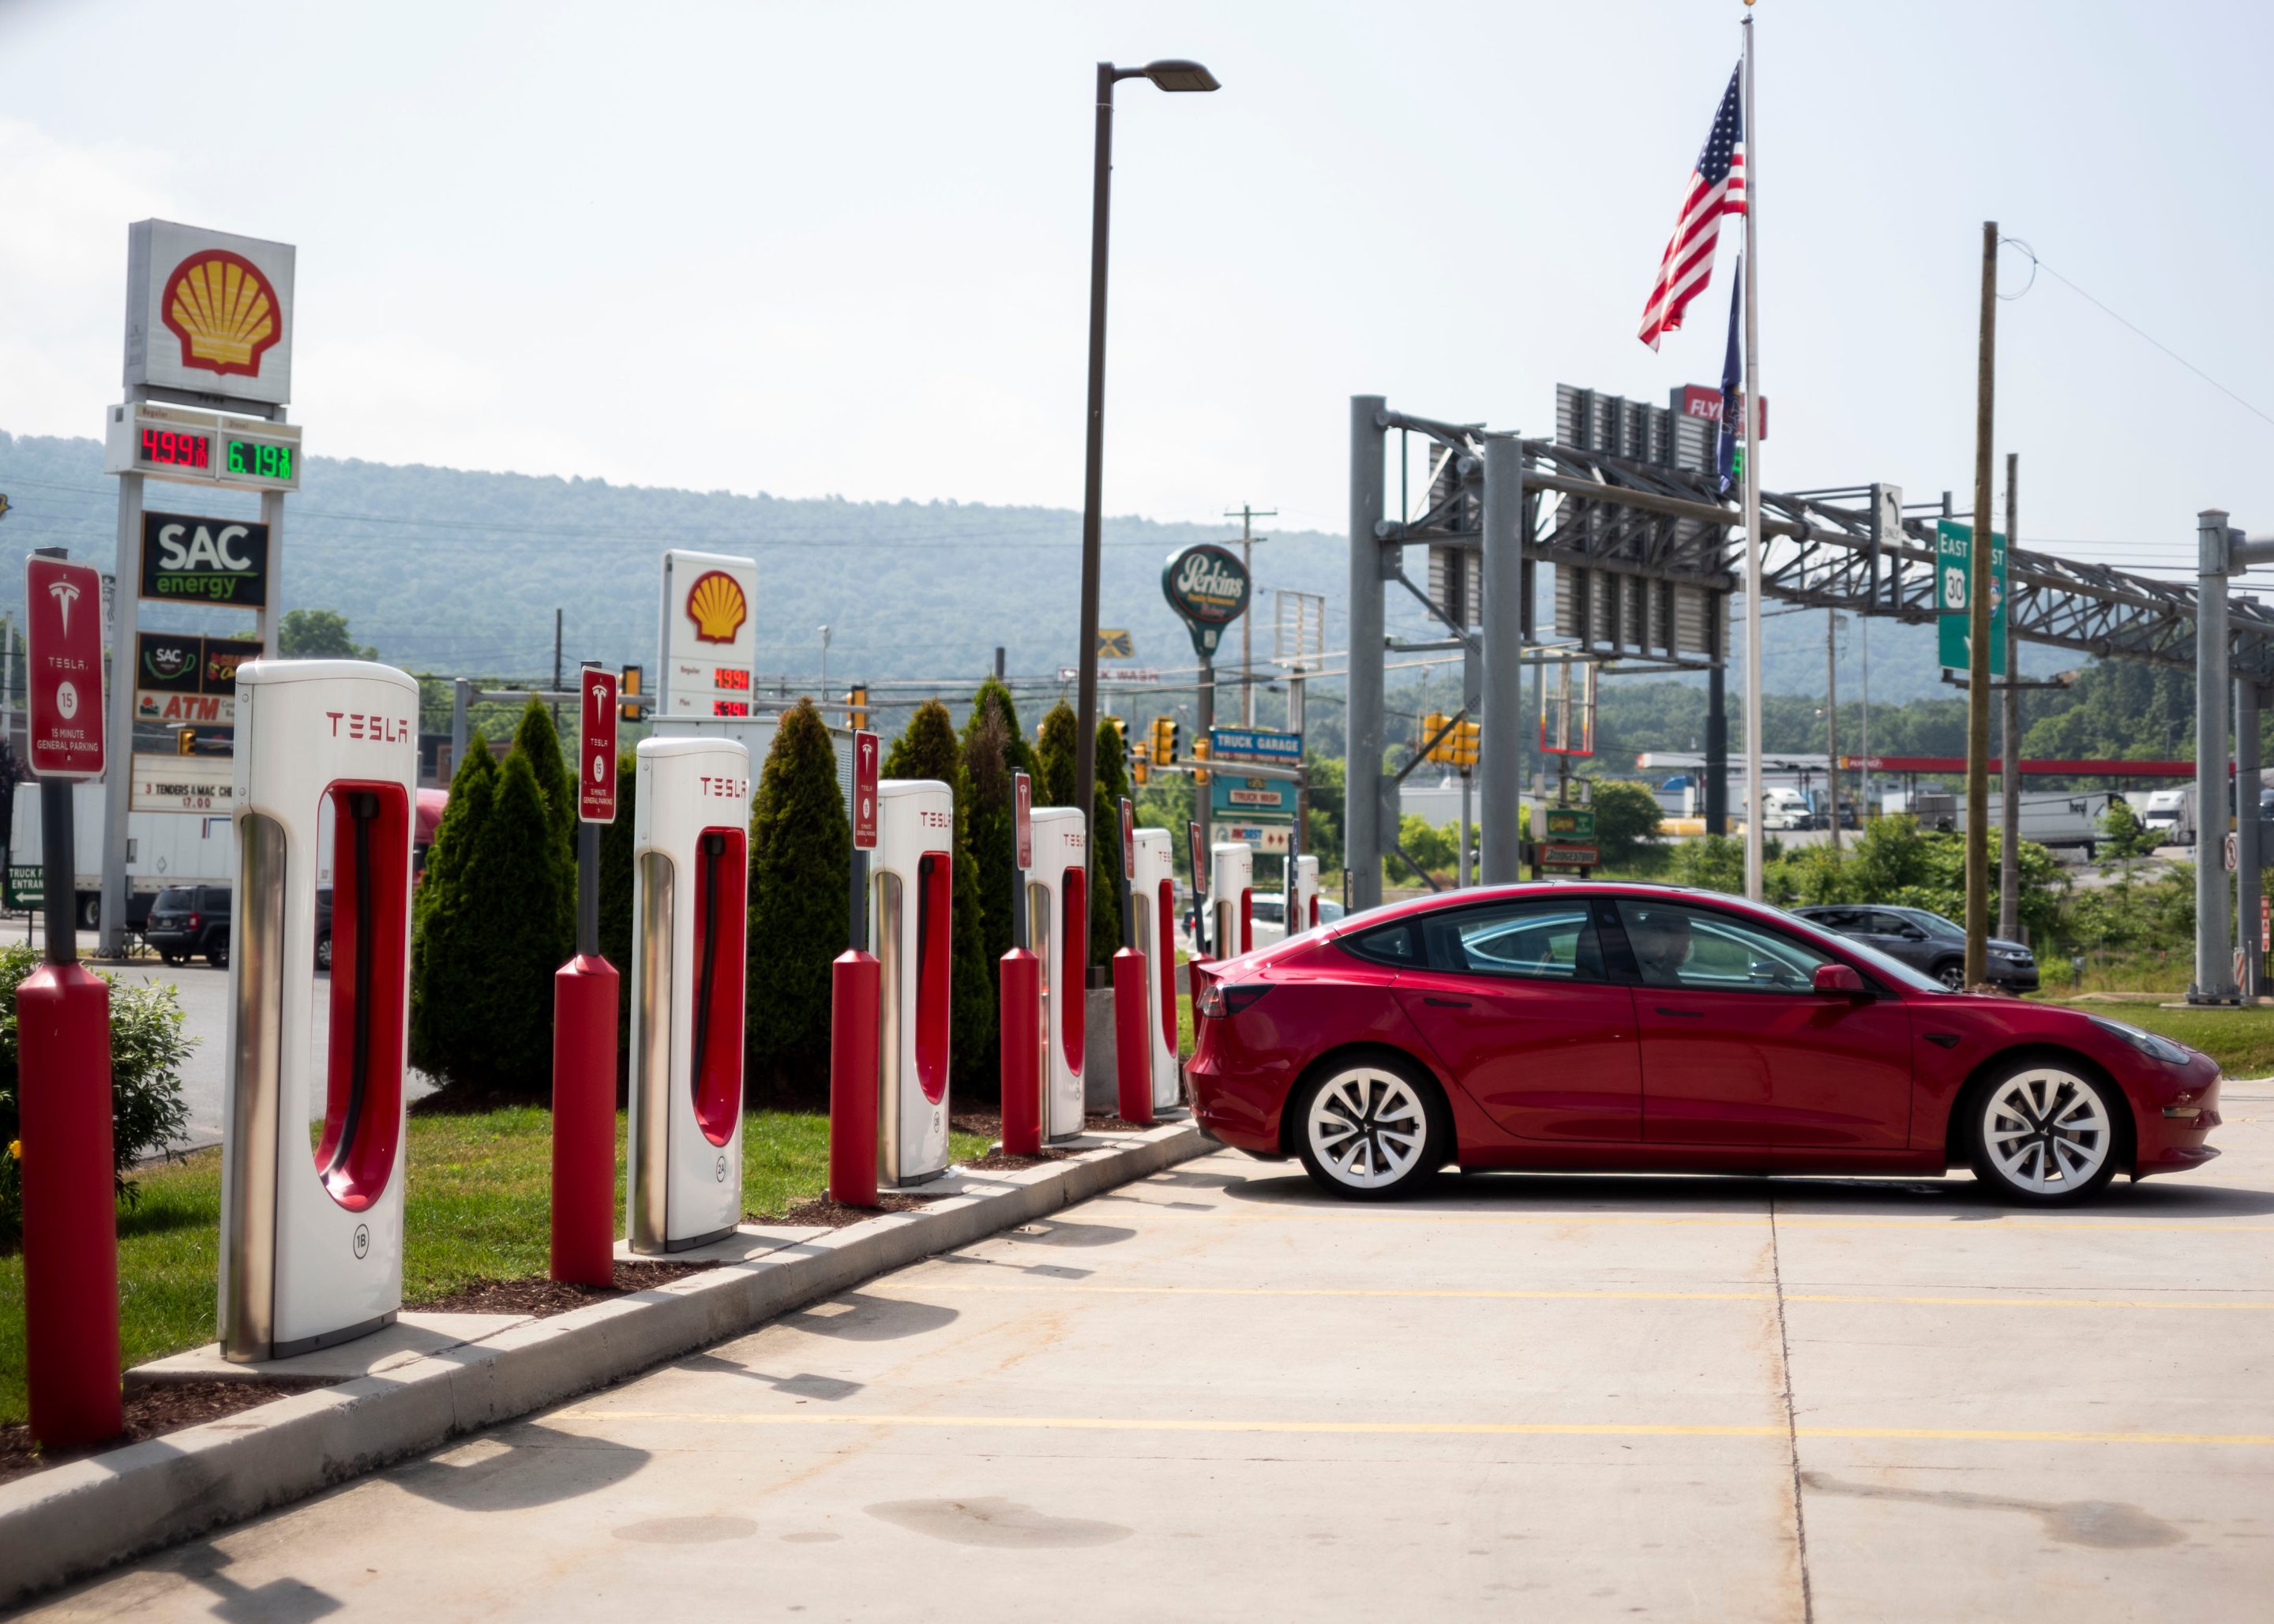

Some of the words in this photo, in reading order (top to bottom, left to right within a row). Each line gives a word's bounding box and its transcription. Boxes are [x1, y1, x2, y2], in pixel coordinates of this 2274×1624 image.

[159, 523, 252, 570] SAC
[1940, 533, 1968, 557] EAST
[1991, 549, 2004, 566] ST
[1178, 553, 1244, 598] Perkins
[156, 577, 236, 598] energy
[1948, 576, 1964, 601] 30
[156, 648, 181, 662] SAC
[62, 692, 73, 708] 15
[163, 696, 220, 720] ATM
[51, 728, 58, 737] 15
[59, 729, 84, 739] MINUTE
[326, 711, 407, 744] TESLA
[37, 740, 69, 751] GENERAL
[69, 741, 99, 752] PARKING
[591, 738, 608, 747] TESLA
[1218, 734, 1253, 748] TRUCK
[1258, 738, 1298, 752] GARAGE
[146, 784, 152, 794] 3
[156, 784, 189, 796] TENDERS
[197, 786, 215, 797] MAC
[219, 786, 232, 797] CHE
[700, 777, 746, 798] TESLA
[9, 868, 36, 878] TRUCK
[12, 880, 43, 889] ENTRAN
[719, 1163, 725, 1174] 2A
[357, 1233, 366, 1248] 1B
